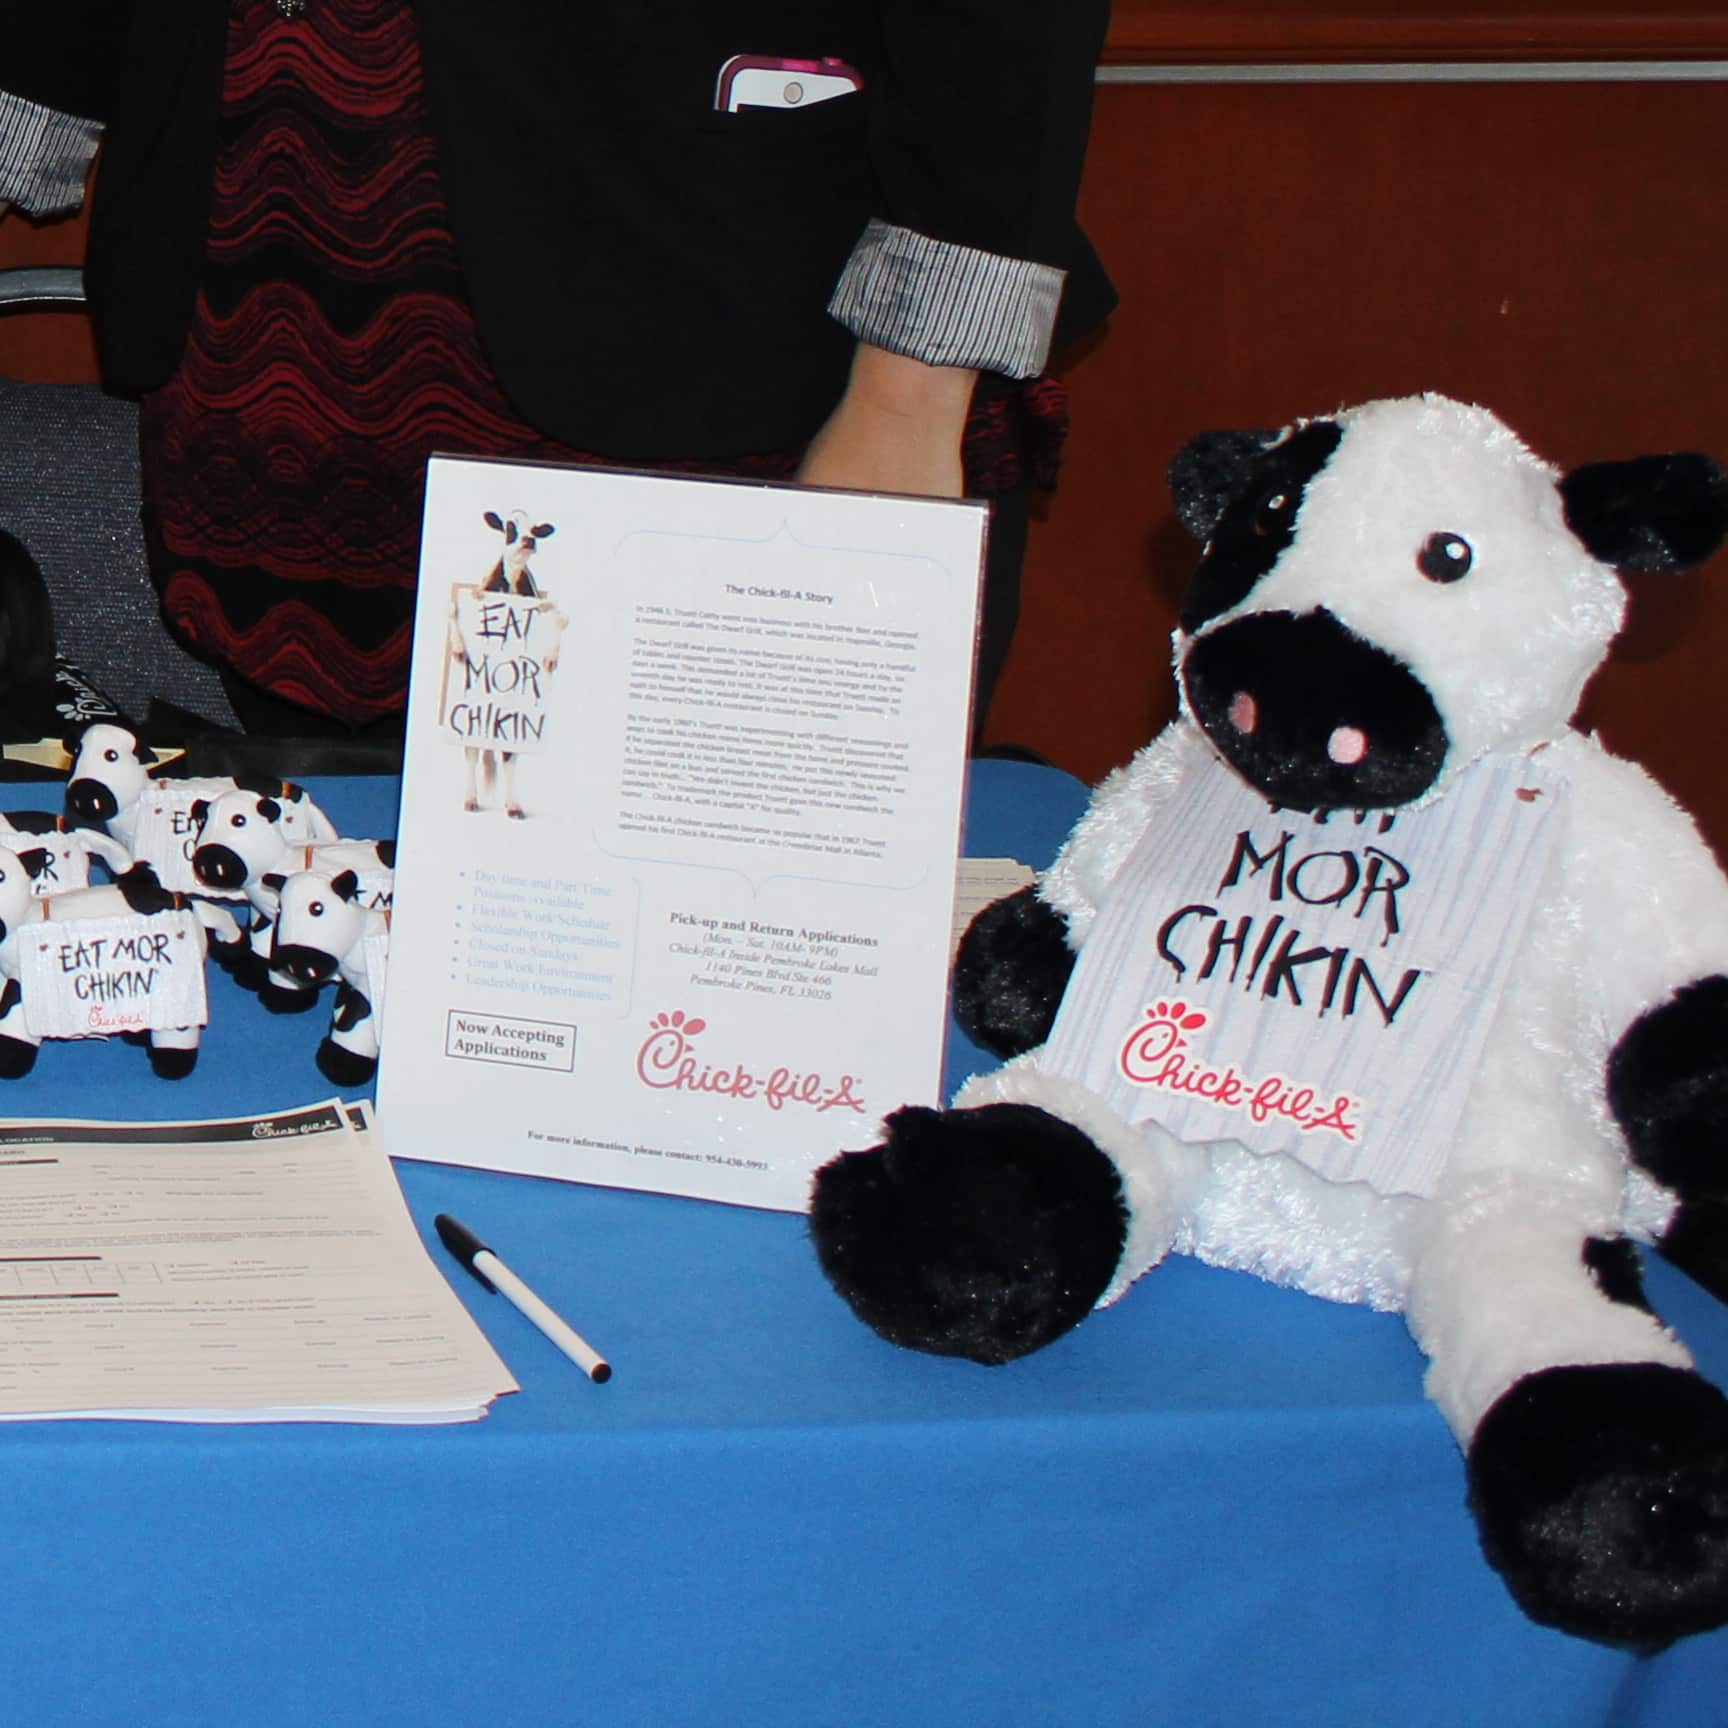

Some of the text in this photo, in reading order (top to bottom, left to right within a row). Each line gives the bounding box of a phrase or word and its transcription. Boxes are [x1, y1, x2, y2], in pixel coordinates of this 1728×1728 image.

[725, 583, 834, 605] The Chick-fil-A Story
[476, 602, 547, 642] EAT
[463, 650, 546, 699] MOR
[449, 702, 545, 740] CHIKIN
[1216, 830, 1410, 947] MOR
[669, 911, 879, 947] Pick-up and Return Applications
[58, 933, 172, 972] EAT MOR
[1157, 905, 1421, 1028] CHIKIN
[75, 968, 155, 1002] CHIKIN
[452, 1037, 548, 1061] Applications
[455, 1018, 565, 1048] Now Accepting
[636, 1009, 866, 1114] Chick-fil-A
[1121, 1001, 1357, 1140] Chick-fil-A
